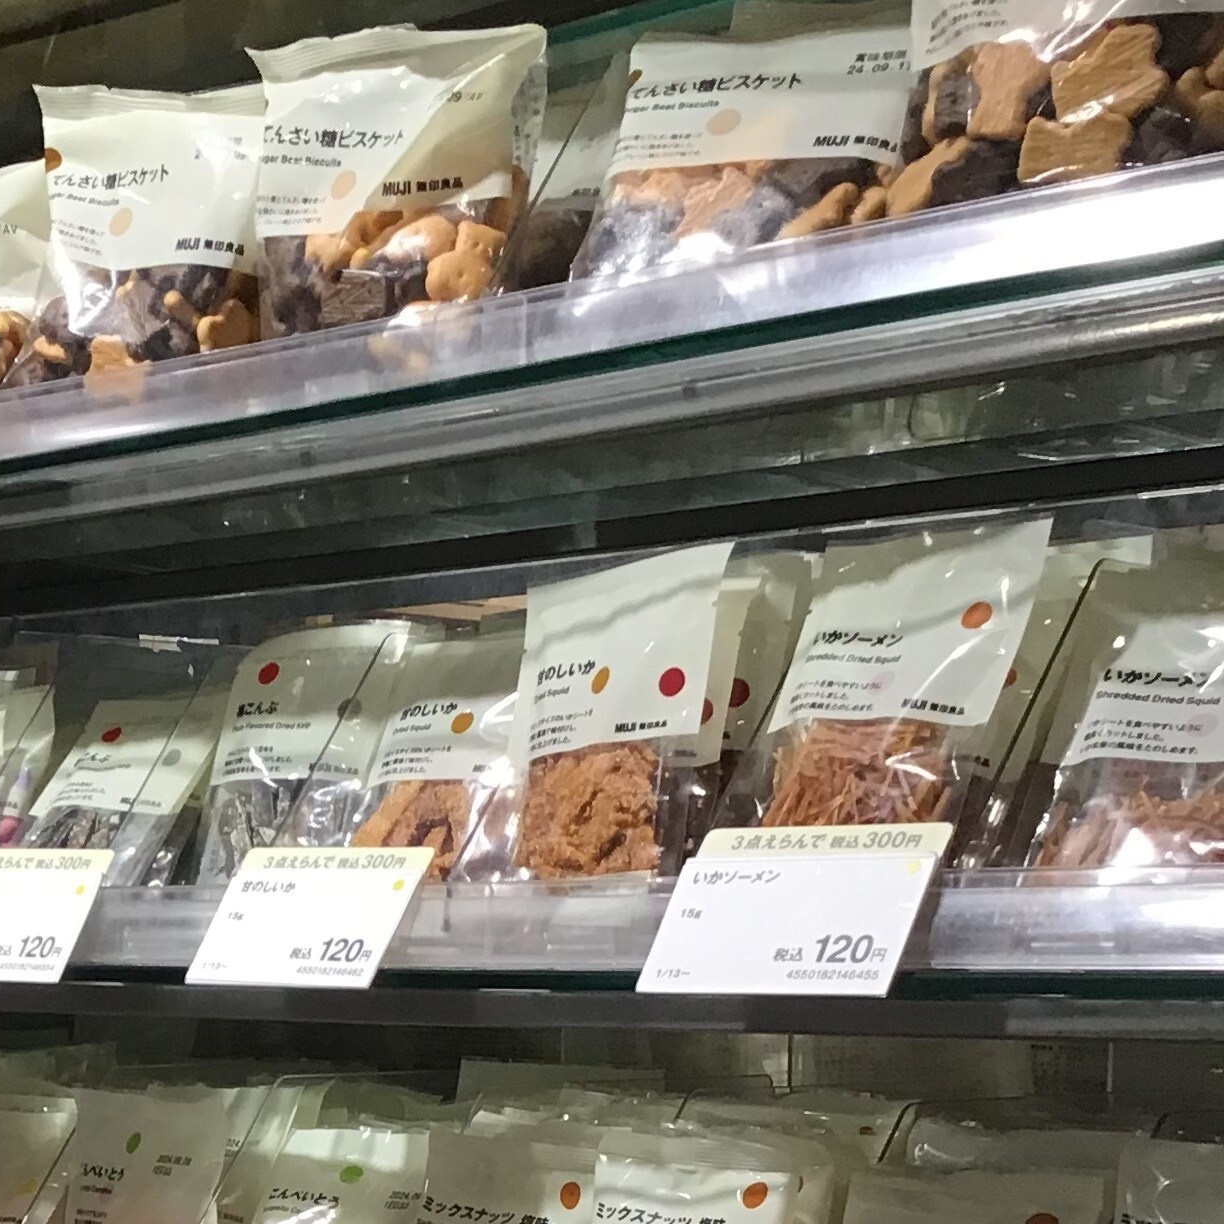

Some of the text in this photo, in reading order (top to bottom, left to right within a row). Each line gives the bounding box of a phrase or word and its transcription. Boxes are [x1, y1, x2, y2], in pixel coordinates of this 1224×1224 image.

[813, 135, 849, 147] MUJI
[382, 177, 464, 196] MUJI 無印良品
[175, 237, 245, 256] MUJI 無印良品
[813, 630, 904, 648] いかソーメン
[846, 654, 902, 665] Dried Squid
[1096, 690, 1221, 707] Shredded Dried Squid
[731, 830, 922, 851] 3点えらんで 税込300円
[263, 854, 406, 870] 3点えらんで 税込300円
[692, 869, 782, 886] いかソーメン
[241, 880, 296, 894] 甘のしいか
[680, 907, 703, 920] 15g
[18, 935, 63, 958] 120円
[289, 937, 373, 963] 税込 120円
[772, 933, 888, 964] 税込 120円
[422, 1196, 515, 1224] ミックスナッツ
